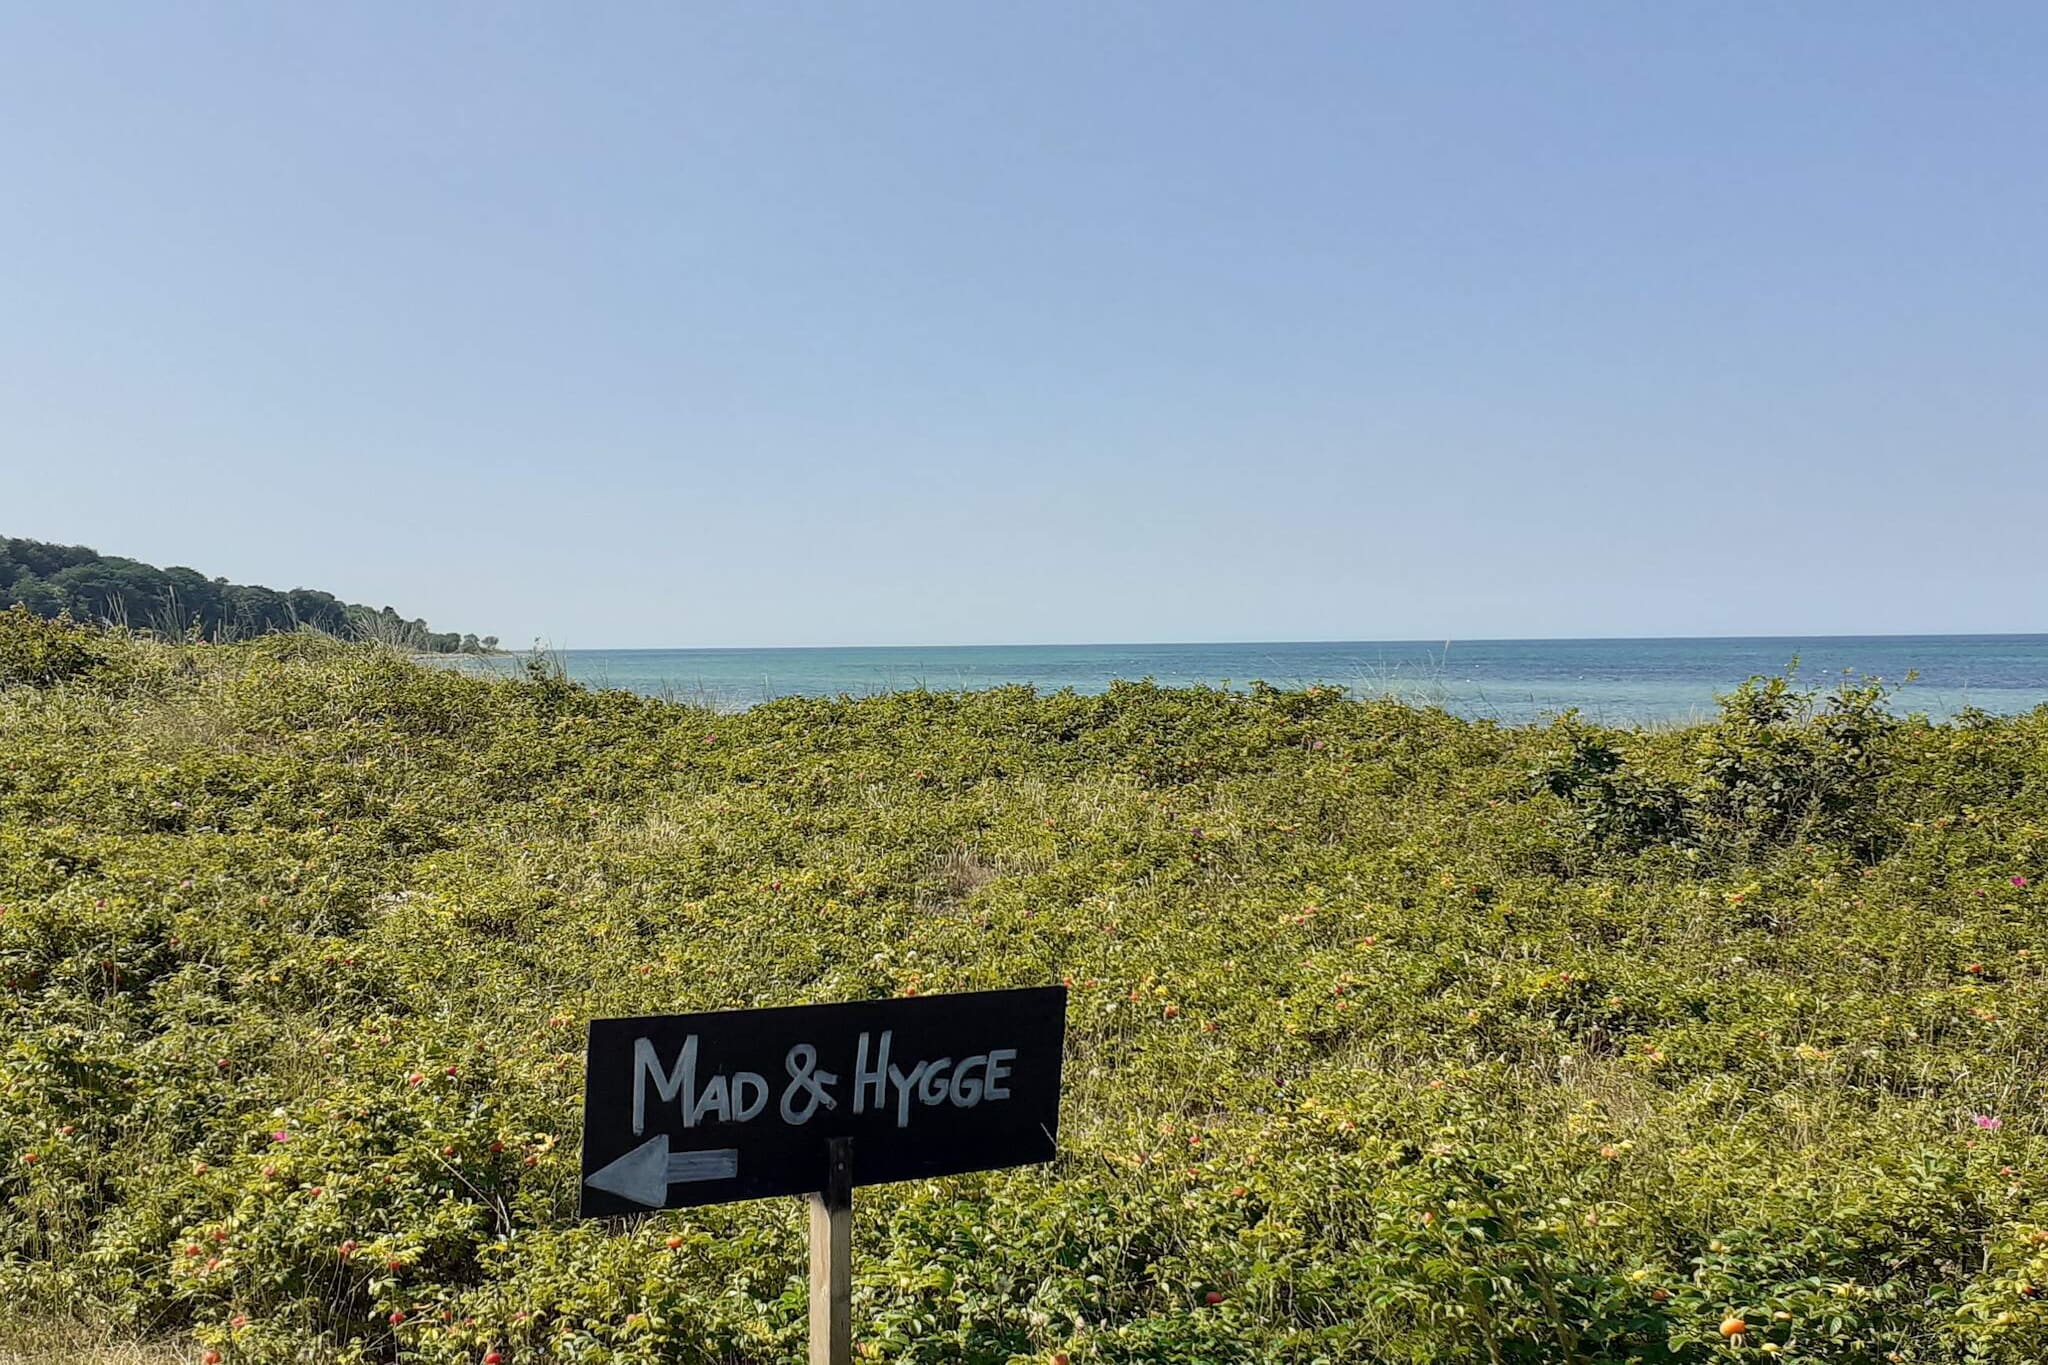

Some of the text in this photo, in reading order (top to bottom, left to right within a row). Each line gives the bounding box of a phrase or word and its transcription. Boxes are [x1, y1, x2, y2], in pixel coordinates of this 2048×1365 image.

[632, 1030, 1018, 1136] MAD & HYGGE
